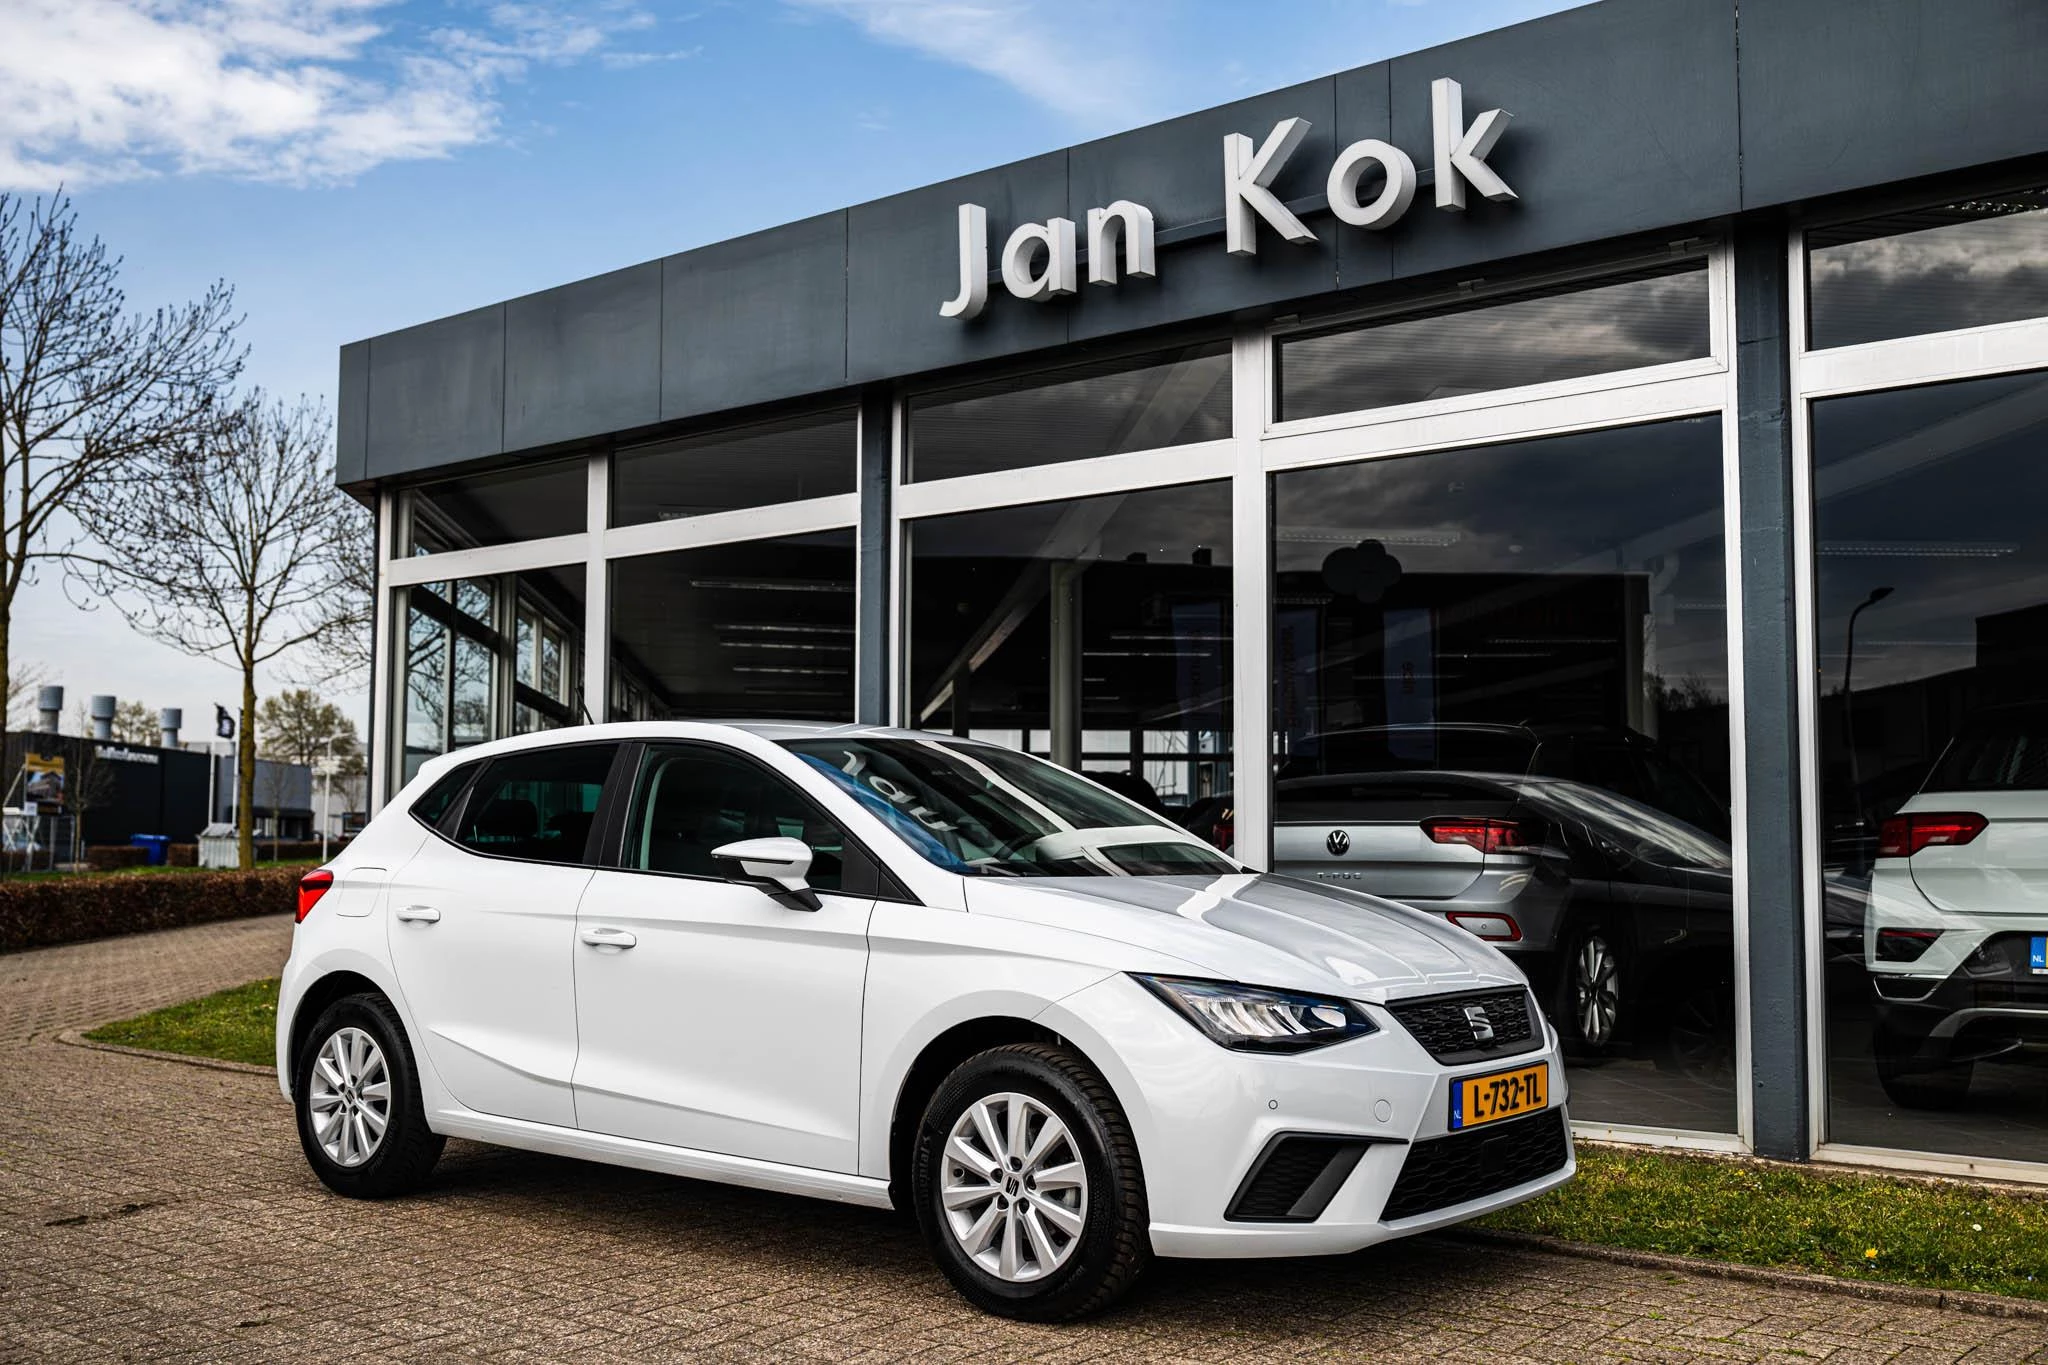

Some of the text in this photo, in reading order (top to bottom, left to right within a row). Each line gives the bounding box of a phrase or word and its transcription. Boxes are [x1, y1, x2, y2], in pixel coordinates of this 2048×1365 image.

[940, 77, 1519, 321] Jan Kok
[2032, 955, 2045, 963] NL
[1453, 1072, 1542, 1120] NL L-732-TL
